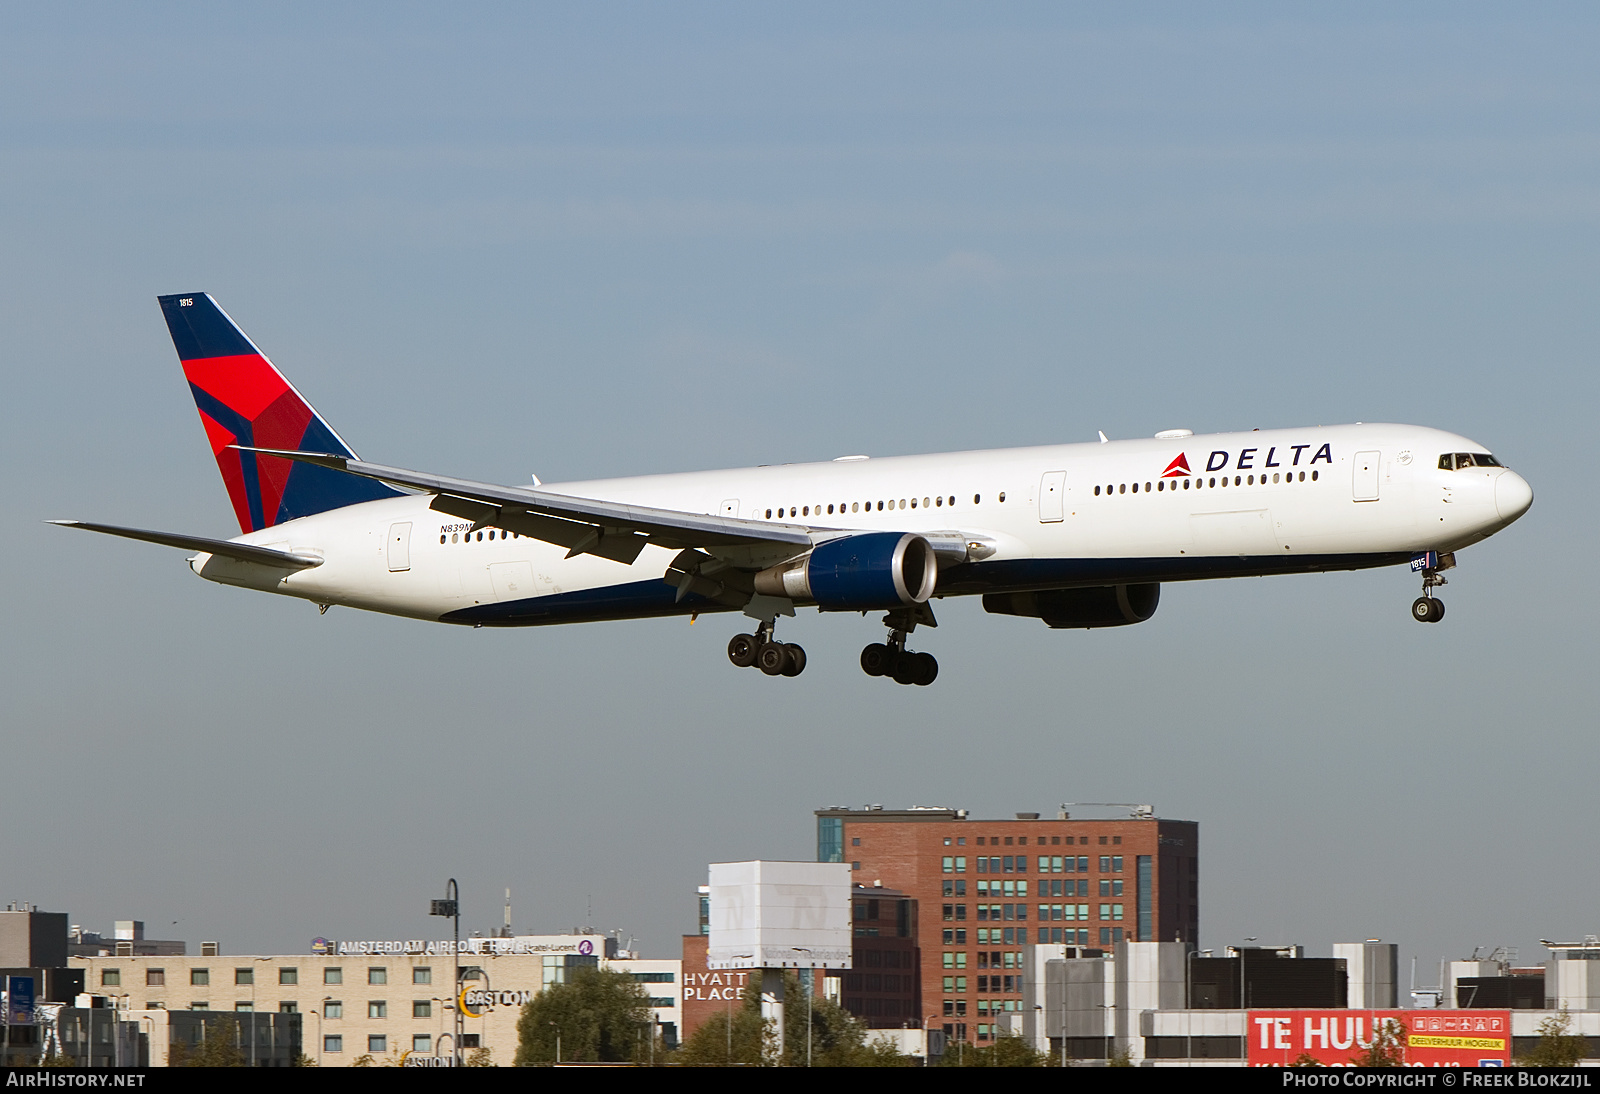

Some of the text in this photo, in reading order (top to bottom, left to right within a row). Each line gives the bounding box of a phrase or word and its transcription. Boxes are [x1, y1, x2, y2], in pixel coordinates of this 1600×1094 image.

[179, 298, 194, 307] 1815
[1206, 442, 1333, 472] DELTA
[1410, 557, 1426, 569] 1815
[339, 941, 423, 952] AMSTERDAM
[525, 944, 577, 952] lcatel-Lucent
[684, 973, 747, 986] HYATT
[465, 991, 531, 1005] BASTION
[684, 987, 746, 1001] PLACE
[1254, 1017, 1401, 1050] TE HUUR
[1410, 1036, 1503, 1049] DEELVERHUUR MOGELIJK
